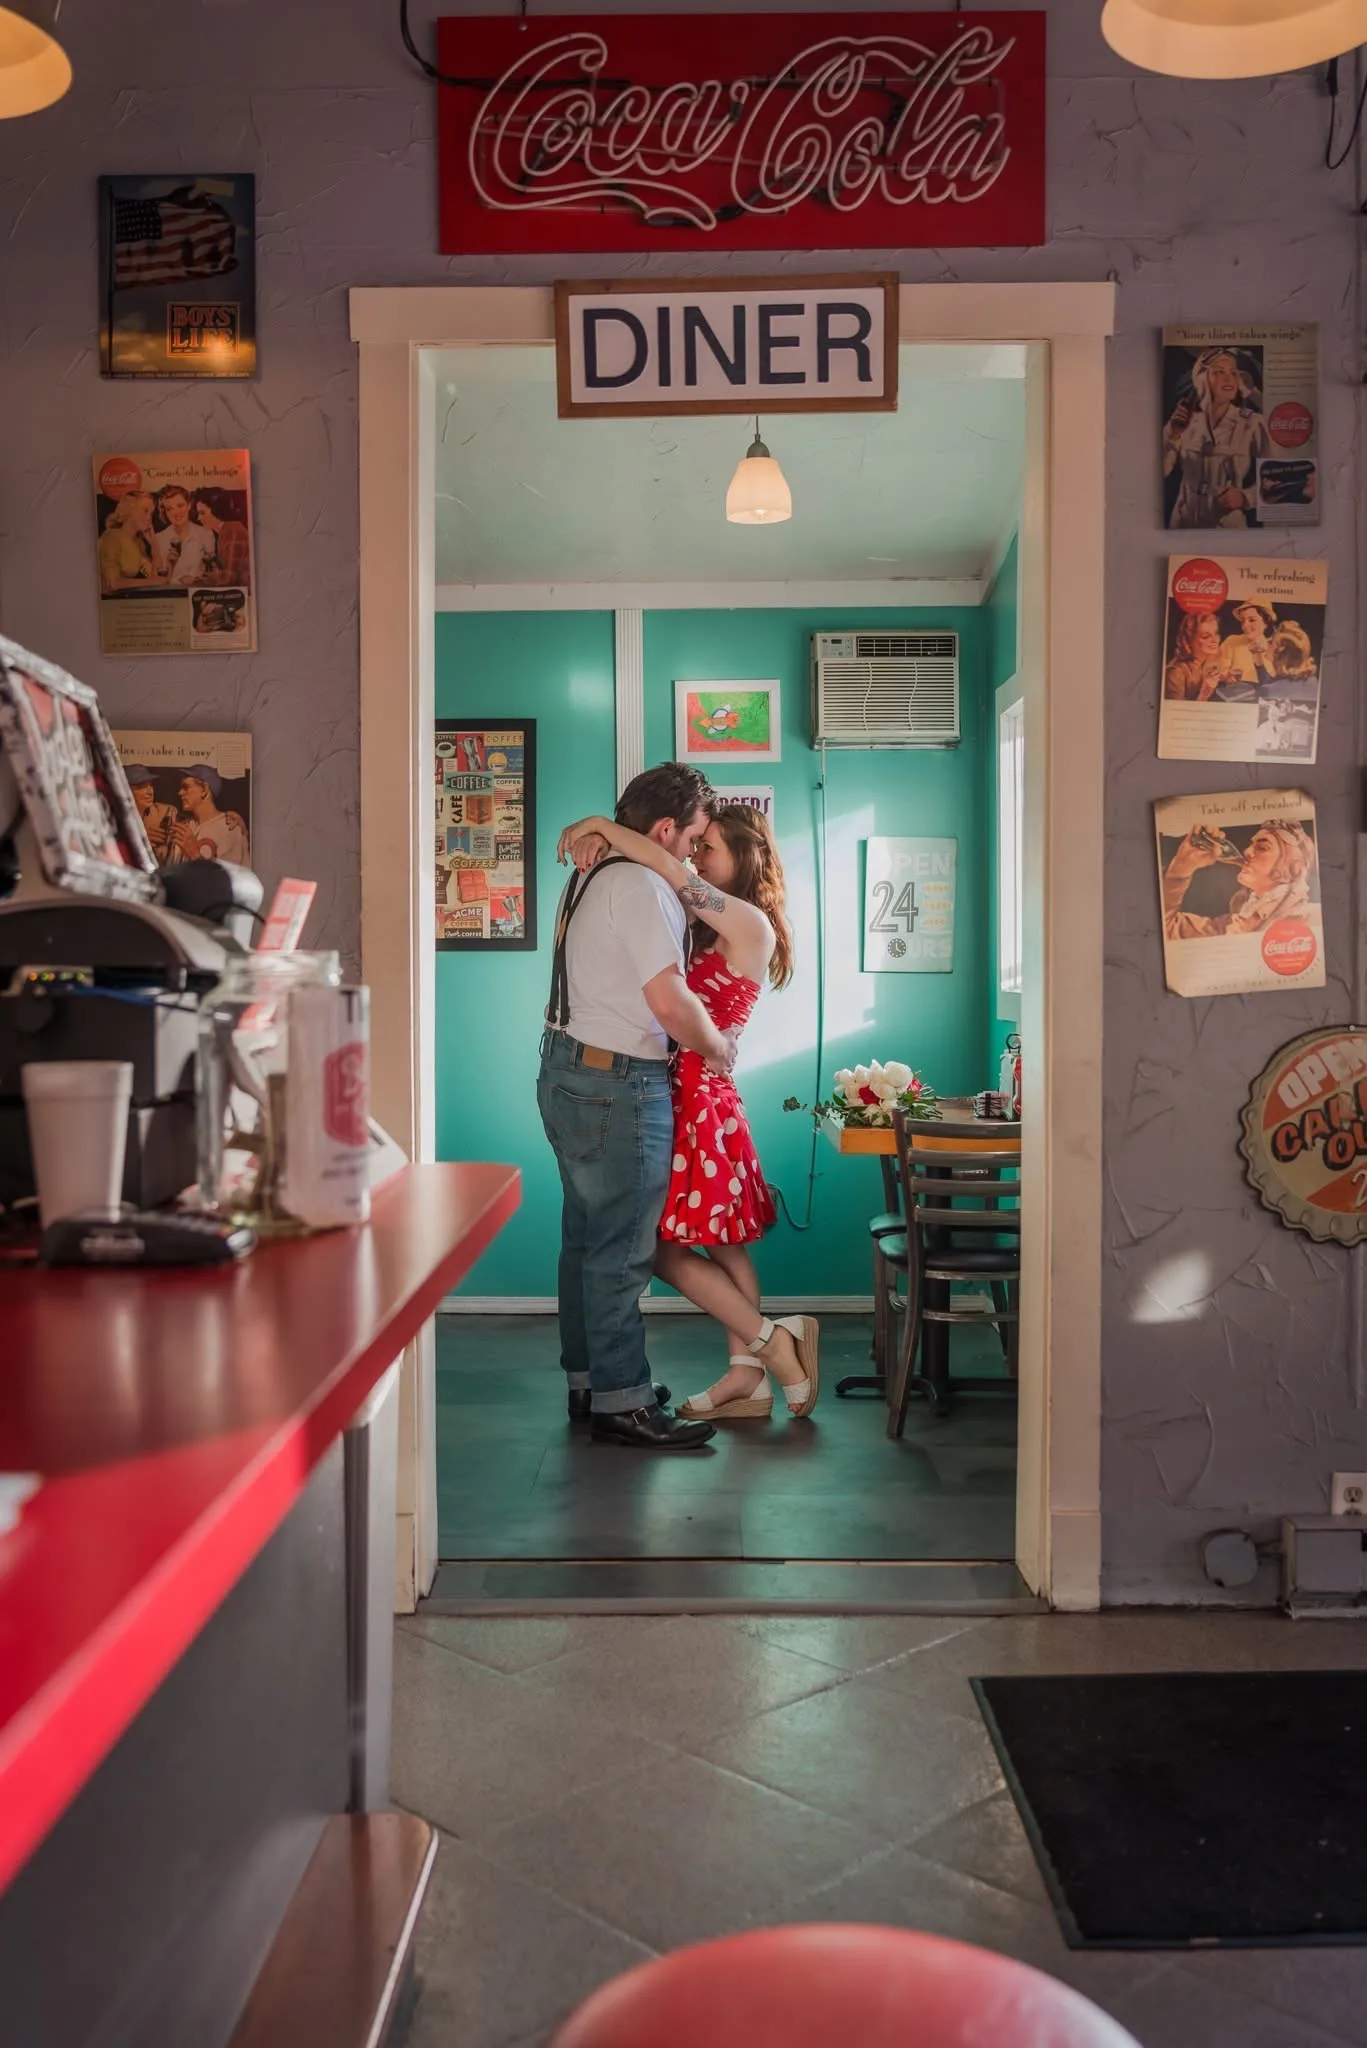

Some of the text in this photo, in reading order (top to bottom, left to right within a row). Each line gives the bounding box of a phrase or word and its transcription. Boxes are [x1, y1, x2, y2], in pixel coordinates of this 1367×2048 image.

[172, 328, 234, 347] LIFE
[1208, 328, 1236, 339] thirst
[1239, 328, 1267, 339] takes
[582, 302, 873, 388] DINER
[1237, 567, 1316, 584] The refreshing
[487, 735, 523, 743] COFFEE
[151, 745, 174, 756] take
[178, 747, 185, 756] it
[450, 776, 487, 790] COFFEE
[1200, 797, 1303, 816] Take off refreshed
[452, 858, 497, 869] COFFEE
[891, 851, 951, 876] PEN
[453, 908, 482, 919] ACME
[869, 880, 919, 933] 24
